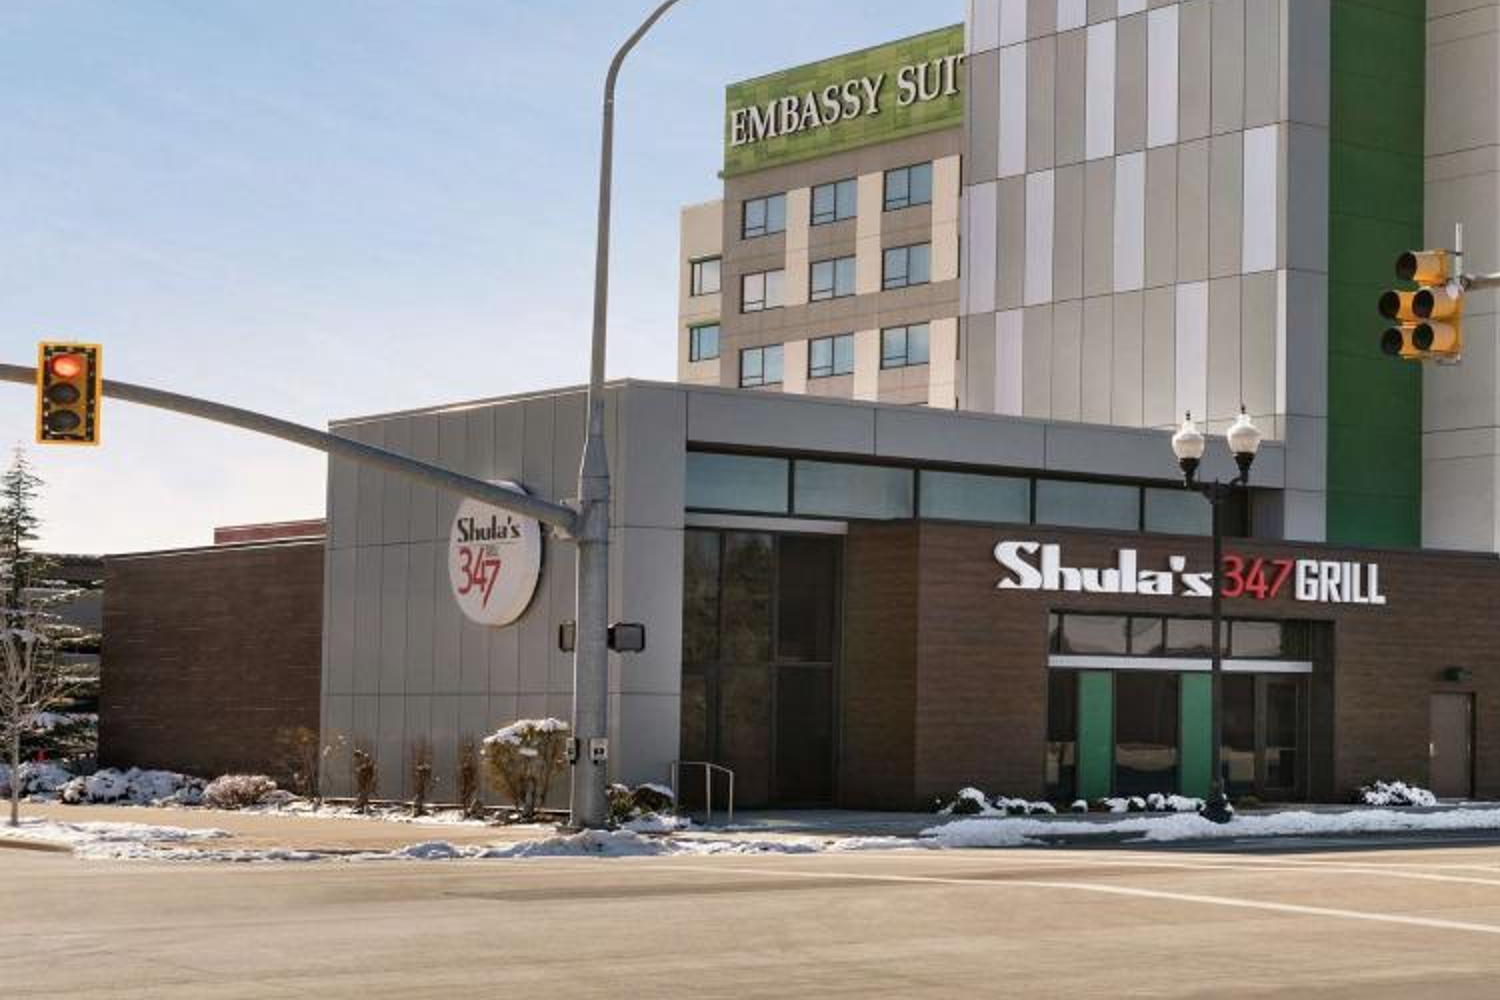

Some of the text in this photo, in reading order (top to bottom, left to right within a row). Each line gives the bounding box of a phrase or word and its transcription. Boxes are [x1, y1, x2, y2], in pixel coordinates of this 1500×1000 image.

[730, 54, 965, 147] EMBASSY SUI
[457, 514, 521, 542] Shula's
[457, 546, 502, 610] 347
[993, 540, 1387, 605] Shula's 347 GRILL
